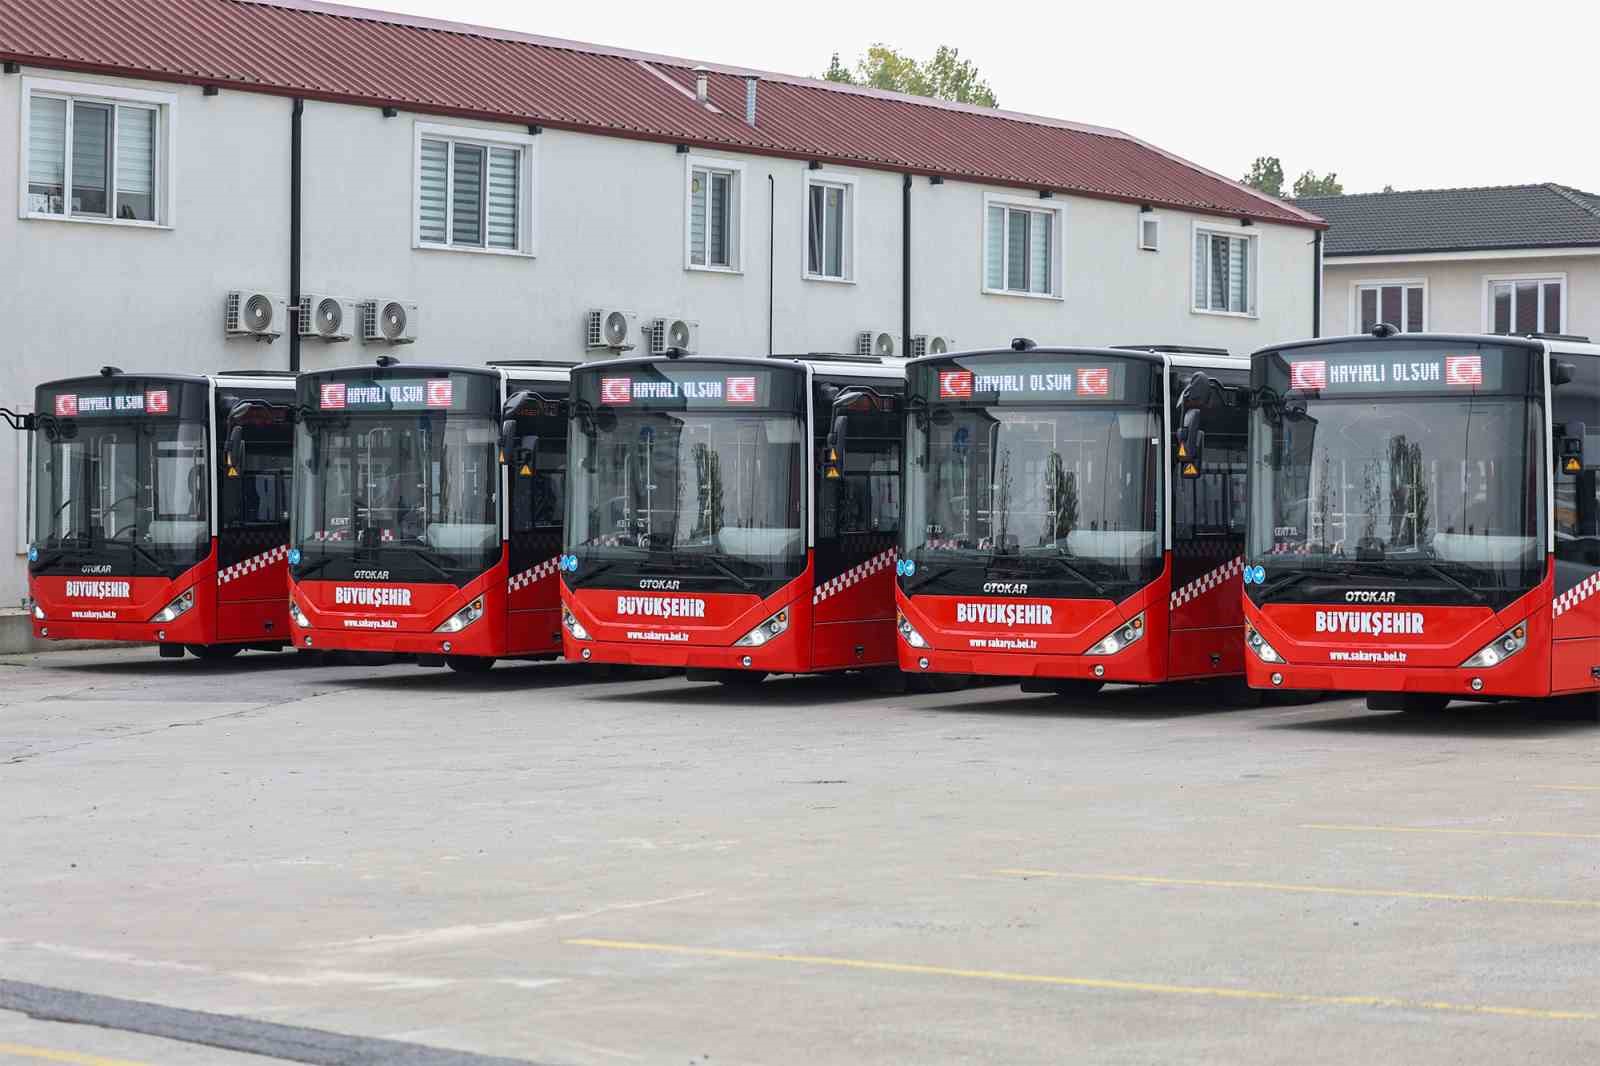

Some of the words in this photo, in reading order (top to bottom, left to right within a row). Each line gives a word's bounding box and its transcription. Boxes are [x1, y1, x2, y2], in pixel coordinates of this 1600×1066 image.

[1331, 365, 1385, 383] HAYIRLI
[1393, 362, 1439, 381] OLSUN
[634, 381, 678, 398] HAYIRLI
[684, 381, 721, 397] OLSUN
[975, 376, 1023, 392] HAYIRLI
[1031, 374, 1071, 390] OLSUN
[348, 388, 385, 403] HAYIRLI
[390, 386, 423, 401] OLSUN
[354, 570, 389, 580] OTOKAR
[640, 579, 679, 590] OTOKAR
[983, 583, 1027, 594] OTOKAR
[336, 587, 411, 607] BÜYÜKŞEHİR
[1345, 591, 1395, 602] OTOKAR
[618, 596, 705, 619] BÜYÜKŞEHİR
[957, 604, 1053, 627] BÜYÜKŞEHİR
[1316, 612, 1424, 637] BÜYÜKŞEHİR
[627, 631, 689, 641] www.sakarya.bel.tr
[1330, 651, 1407, 662] www.sakarya.bel.tr
